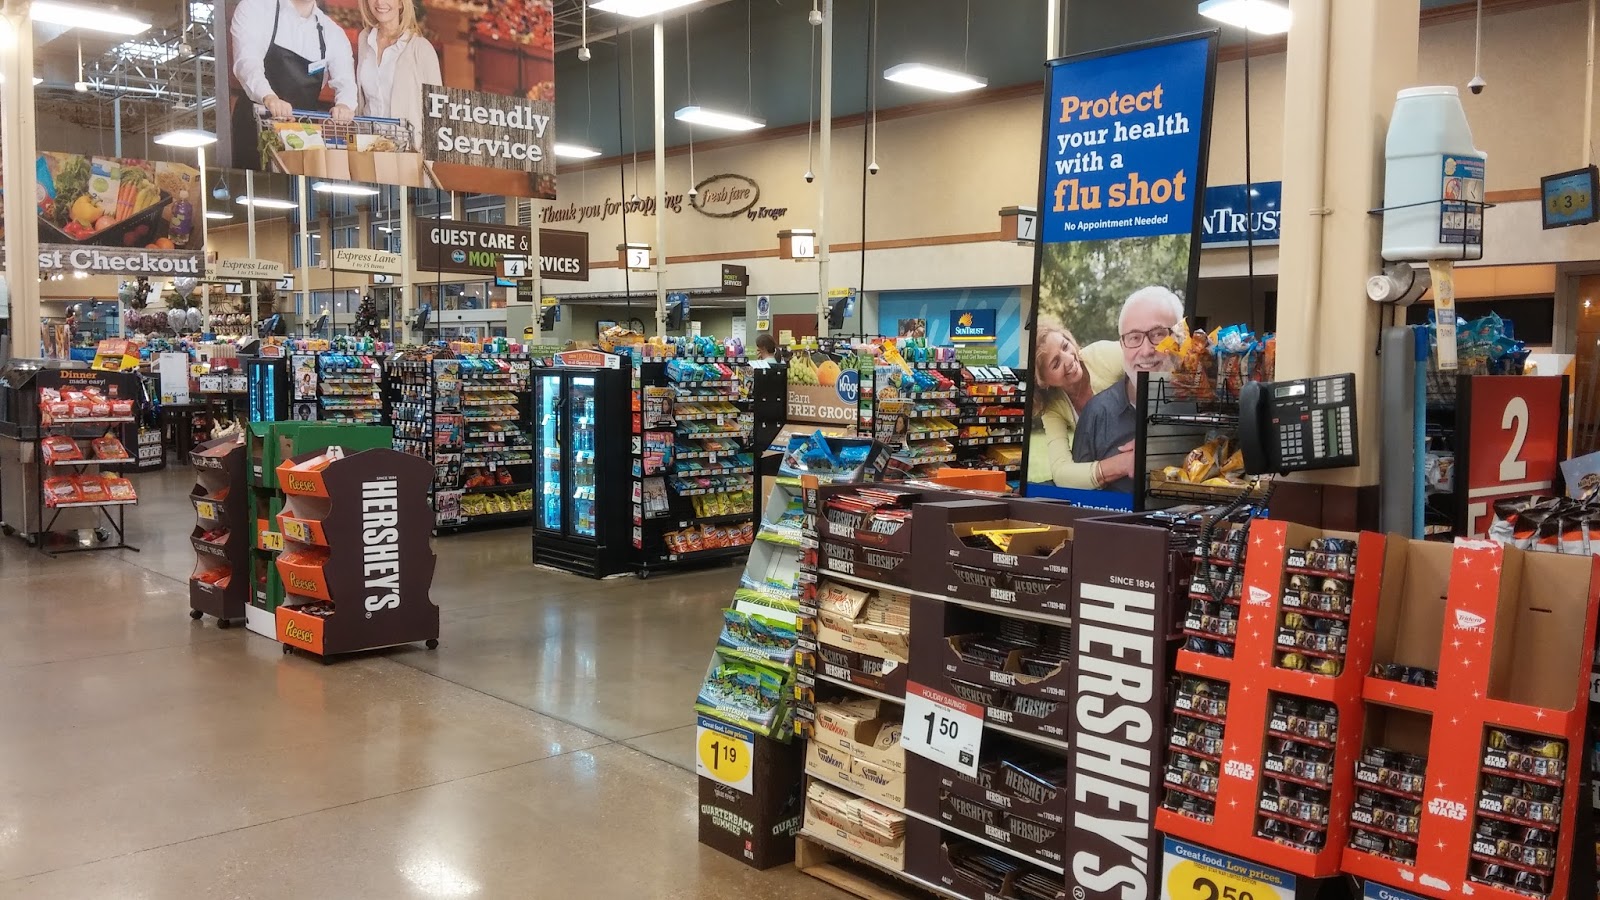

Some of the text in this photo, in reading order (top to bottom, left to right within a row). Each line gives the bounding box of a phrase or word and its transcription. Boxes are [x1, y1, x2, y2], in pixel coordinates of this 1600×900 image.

[1059, 83, 1163, 123] Protect
[429, 93, 550, 138] Friendly
[1057, 112, 1189, 155] your health
[438, 127, 542, 162] Service
[1055, 151, 1124, 175] with a
[702, 186, 750, 208] fresh fare
[1053, 169, 1186, 212] flu shot
[541, 203, 576, 223] Thank
[578, 202, 600, 222] you
[602, 198, 621, 221] for
[1564, 195, 1572, 208] 3
[747, 206, 788, 221] by Kroger
[1202, 207, 1281, 234] NTRUS
[1024, 217, 1033, 237] 7
[1064, 214, 1168, 232] No Appointment Needed
[430, 228, 529, 251] GUEST CARE &
[39, 249, 198, 274] st Checkout
[222, 260, 279, 271] Express Lane
[337, 250, 396, 264] Express Lane
[469, 252, 498, 268] MON
[635, 251, 642, 266] 5
[510, 262, 518, 274] 4
[281, 280, 289, 288] 2
[60, 371, 97, 379] Dinner
[839, 374, 858, 400] Kroge
[788, 391, 810, 404] Earn
[788, 403, 858, 420] FREE GROCE
[1499, 396, 1529, 482] 2
[829, 522, 855, 539] HERSHEY'S
[871, 519, 904, 535] HERSHE
[271, 534, 279, 547] 74
[362, 480, 400, 613] HERSHEY'S
[825, 542, 854, 561] ERSHEY'S
[992, 552, 1019, 566] HERSHEY'S
[828, 557, 855, 575] HERSHEY'S
[1110, 575, 1156, 590] SINCE 1894
[990, 588, 1017, 602] HERSHEY'S
[1452, 623, 1486, 633] WHITE
[1459, 615, 1482, 623] Trident
[825, 663, 852, 681] HERSHEY'S
[989, 670, 1016, 686] HERSHEY'S
[922, 689, 944, 702] HOLIDAY
[987, 706, 1014, 723] HERSHEY'S
[702, 720, 714, 729] Great
[714, 723, 723, 732] food.
[724, 726, 733, 734] Low
[733, 731, 748, 740] prices.
[924, 711, 936, 745] 1
[939, 717, 959, 740] 50
[1072, 583, 1155, 900] HERSHEY'S
[710, 740, 737, 770] 1 19
[1225, 759, 1253, 771] STAR
[1225, 766, 1255, 781] WARS
[985, 789, 1012, 808] HERSHEY'S
[1428, 797, 1465, 811] STAR
[701, 804, 754, 835] QUARTERBACK
[1429, 805, 1467, 821] WARS
[712, 816, 741, 836] GUMMIES
[985, 824, 1011, 843] HERSHEY'S
[1175, 845, 1283, 885] Great food. Low prices.
